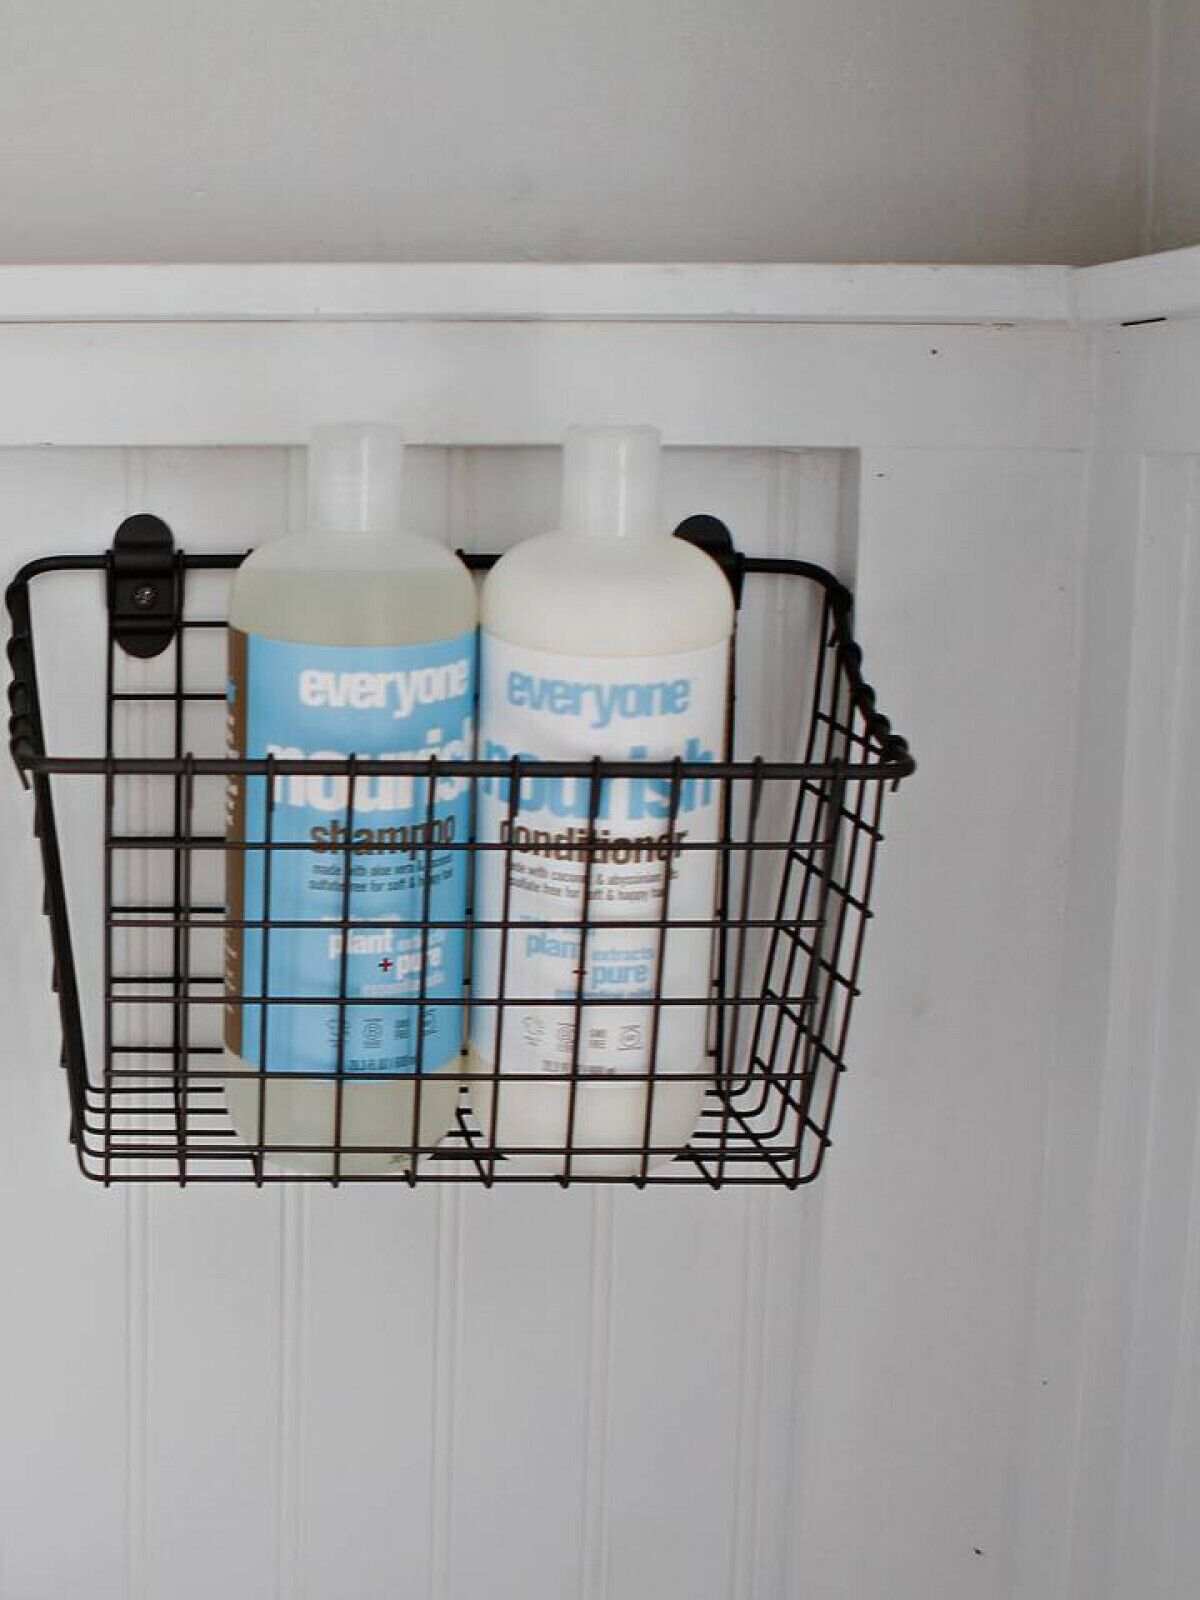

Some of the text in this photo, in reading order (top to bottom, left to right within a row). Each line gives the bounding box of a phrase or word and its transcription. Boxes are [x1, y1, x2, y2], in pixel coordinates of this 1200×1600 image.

[300, 660, 470, 719] everyone
[508, 671, 691, 728] everyone
[527, 931, 584, 959] plan
[396, 947, 442, 980] pue
[590, 964, 649, 989] pure
